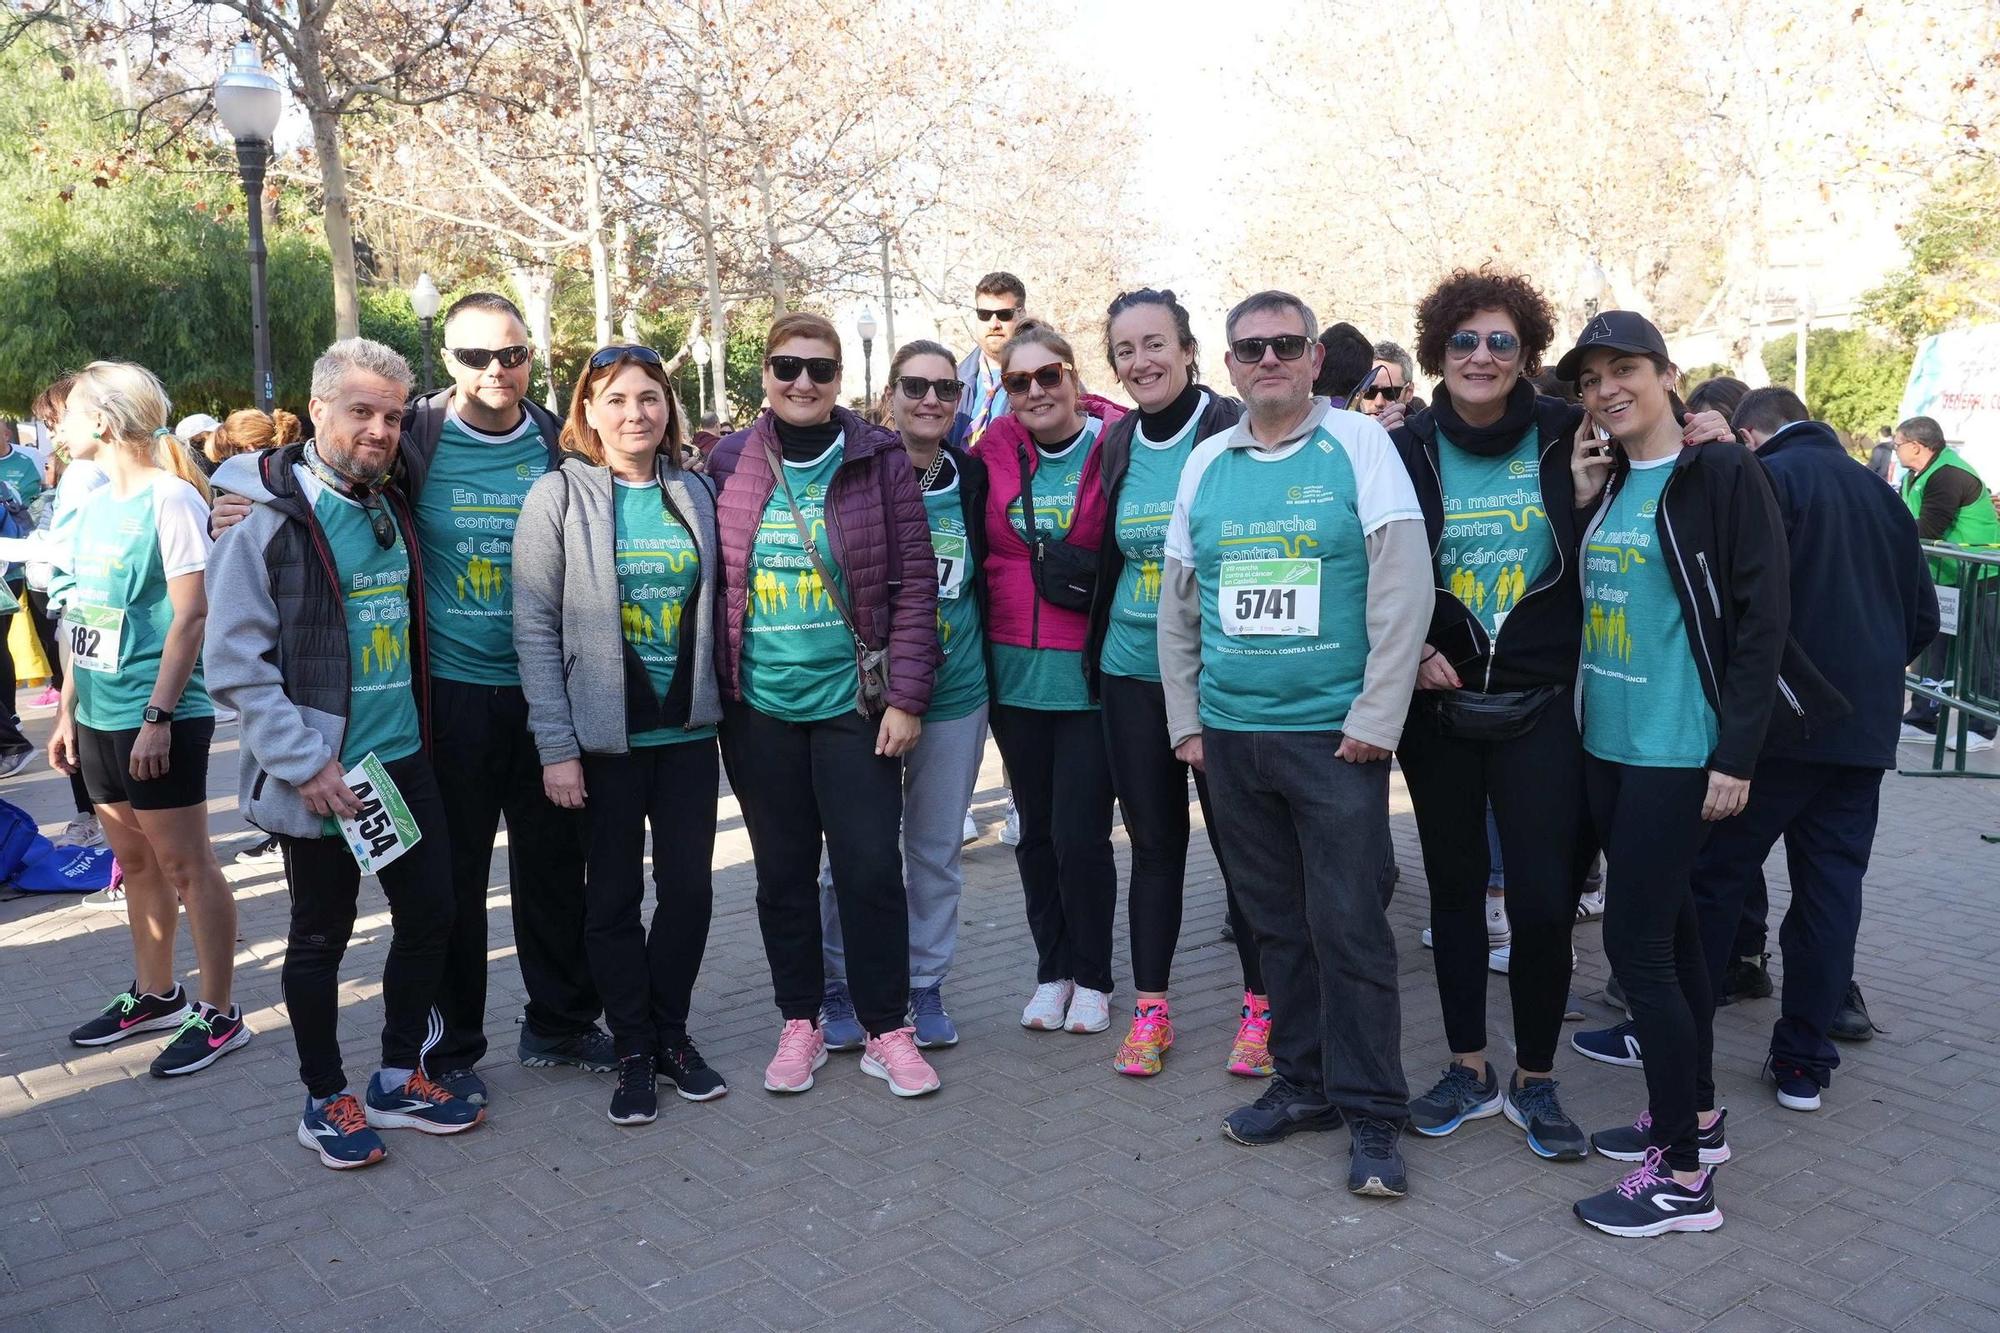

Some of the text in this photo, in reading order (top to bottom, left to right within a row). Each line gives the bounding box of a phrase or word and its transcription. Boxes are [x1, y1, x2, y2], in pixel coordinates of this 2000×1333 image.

[452, 489, 478, 504] En
[1032, 492, 1077, 507] march
[1468, 488, 1542, 509] marcha
[454, 516, 515, 530] contra
[1221, 514, 1317, 537] En marcha
[754, 530, 799, 544] ontra
[1120, 525, 1169, 539] contra
[456, 537, 513, 554] el cán
[633, 534, 695, 550] marcha
[1221, 547, 1279, 561] contra
[1440, 546, 1528, 566] el cáncer
[615, 560, 665, 576] ontra
[353, 573, 373, 589] En
[630, 583, 685, 601] cáncer
[1585, 580, 1595, 599] el
[1236, 589, 1296, 620] 5741
[801, 622, 825, 630] CONTRA
[1244, 648, 1278, 656] ESPAÑOLA
[1278, 646, 1306, 655] CONTRA
[1315, 642, 1341, 651] CÁNCER
